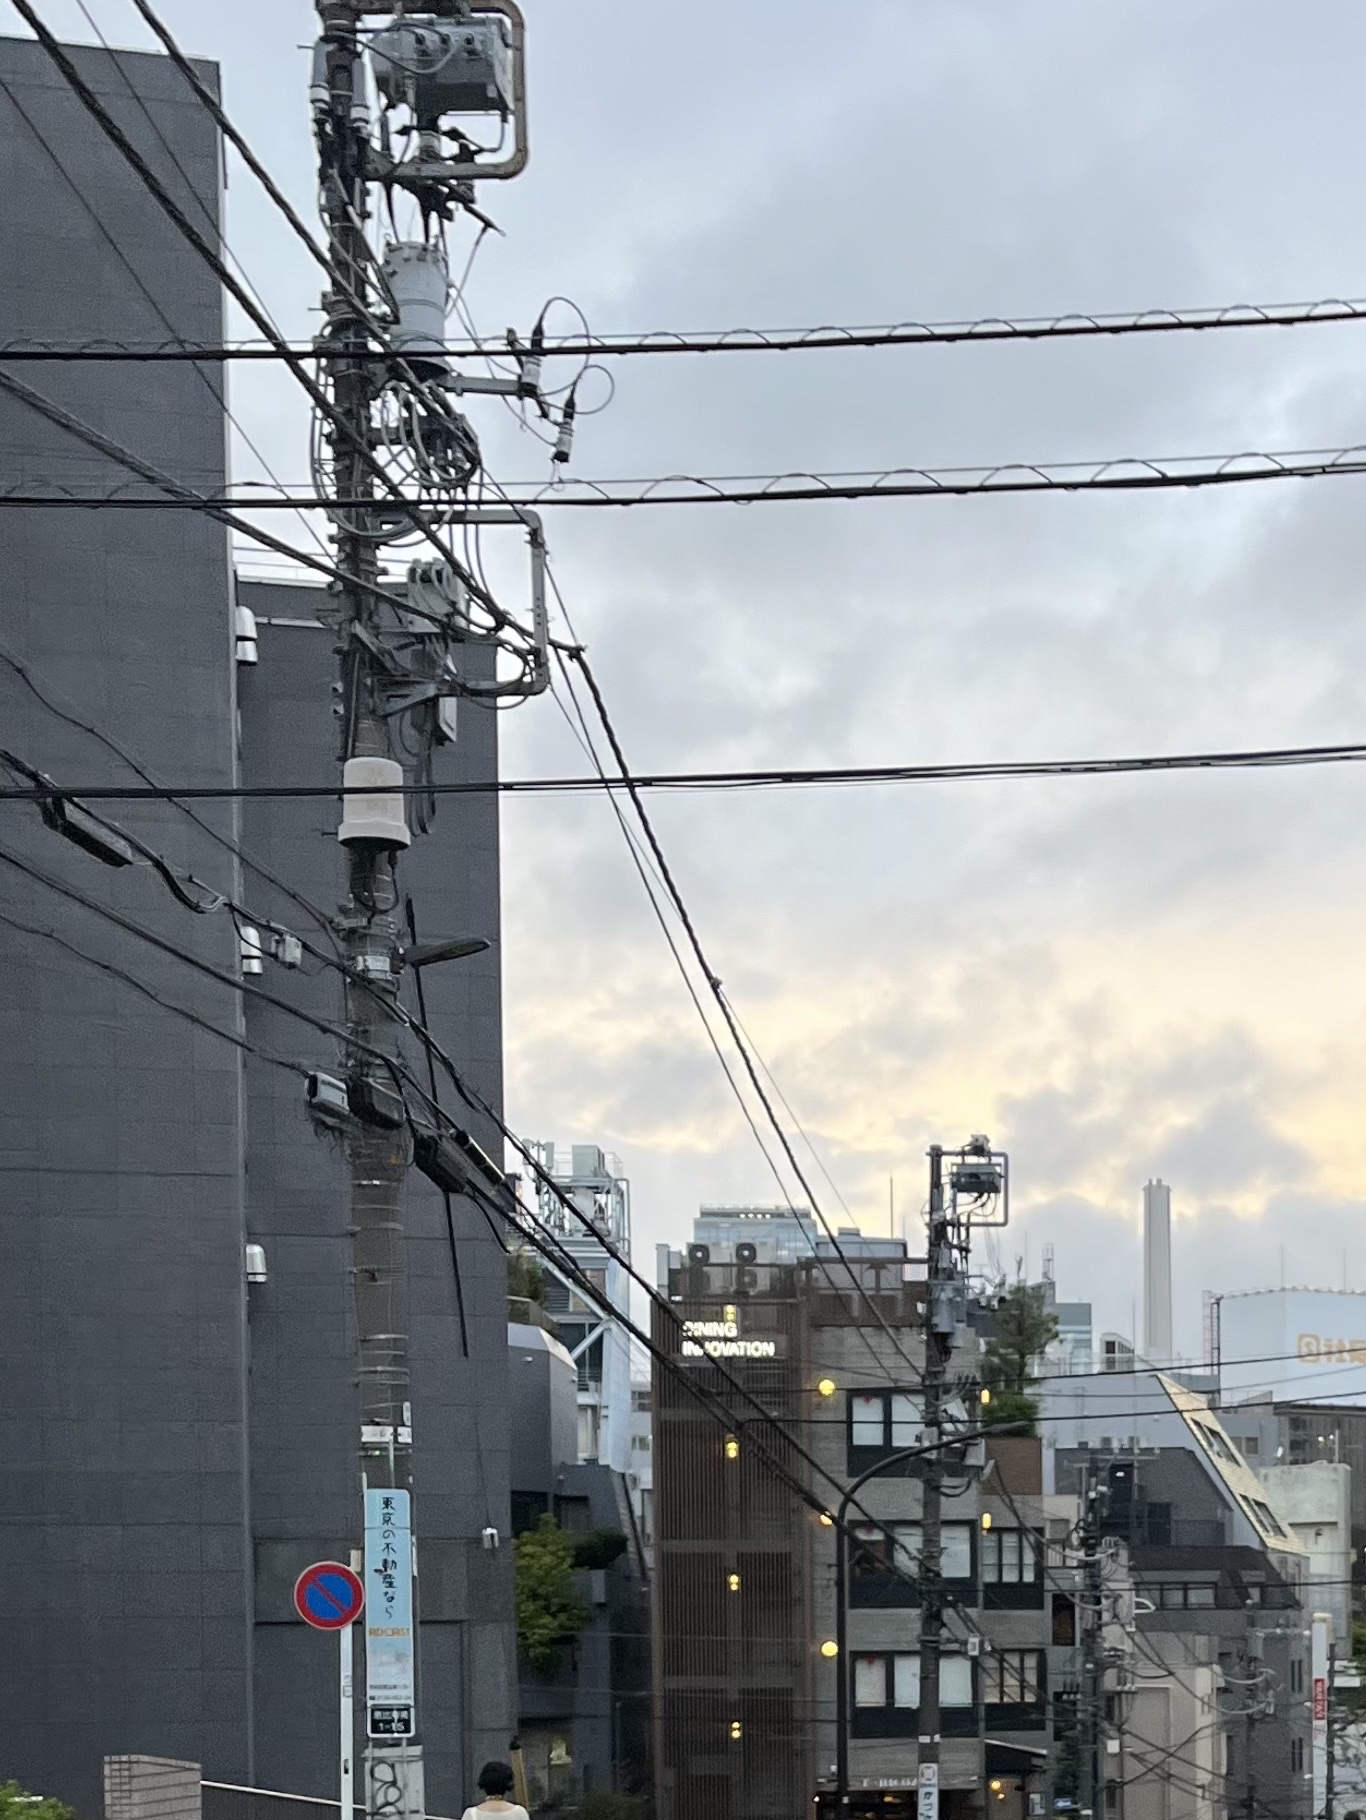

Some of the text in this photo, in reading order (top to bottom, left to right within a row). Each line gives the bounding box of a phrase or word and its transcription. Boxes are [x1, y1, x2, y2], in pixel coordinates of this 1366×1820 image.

[381, 1496, 397, 1619] 東京の不動産なら
